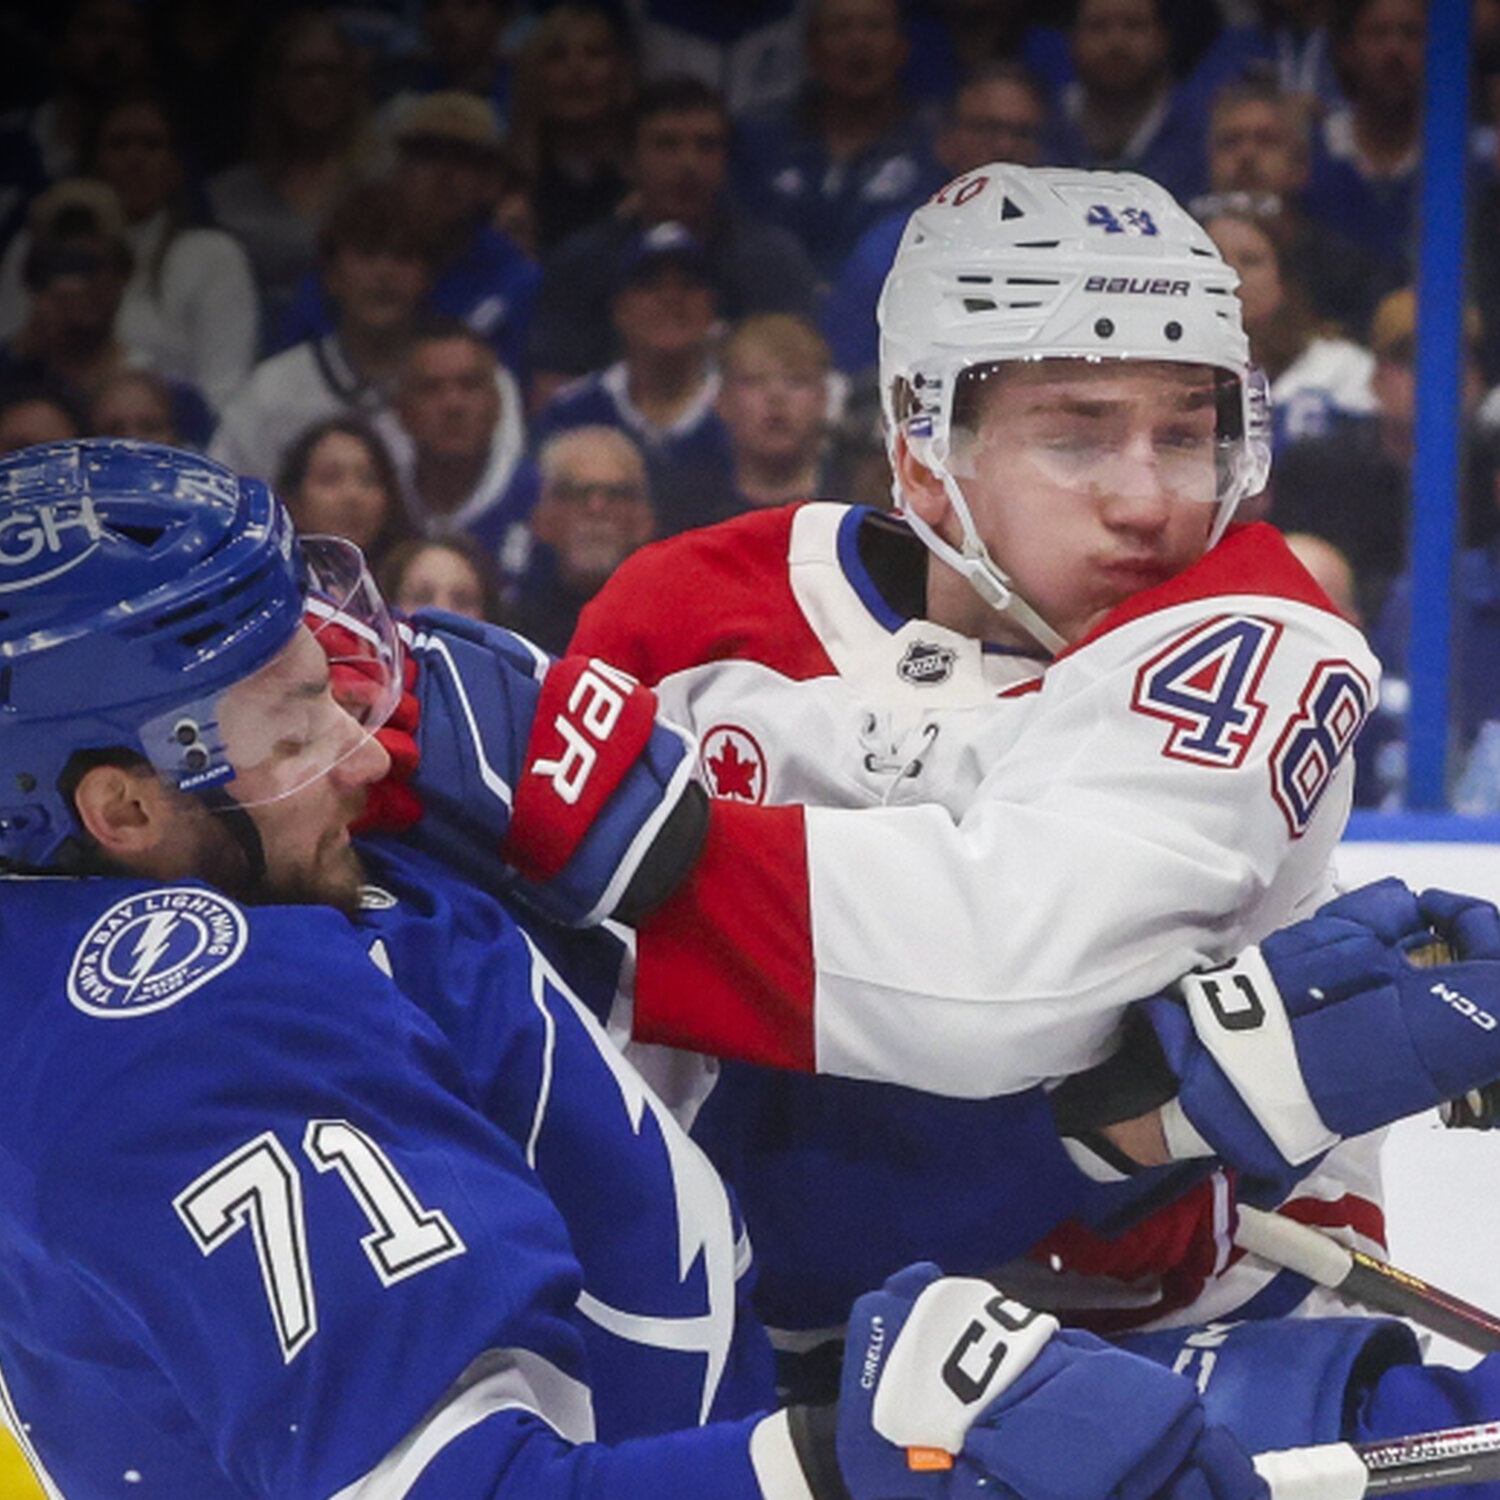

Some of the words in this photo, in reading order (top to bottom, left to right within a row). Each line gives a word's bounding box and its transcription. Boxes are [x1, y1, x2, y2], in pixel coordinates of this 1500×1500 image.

[1083, 276, 1192, 297] BAUER
[1130, 614, 1372, 840] 48
[93, 905, 134, 945] BAY
[1430, 982, 1498, 1032] CCM
[171, 1119, 468, 1366] 71
